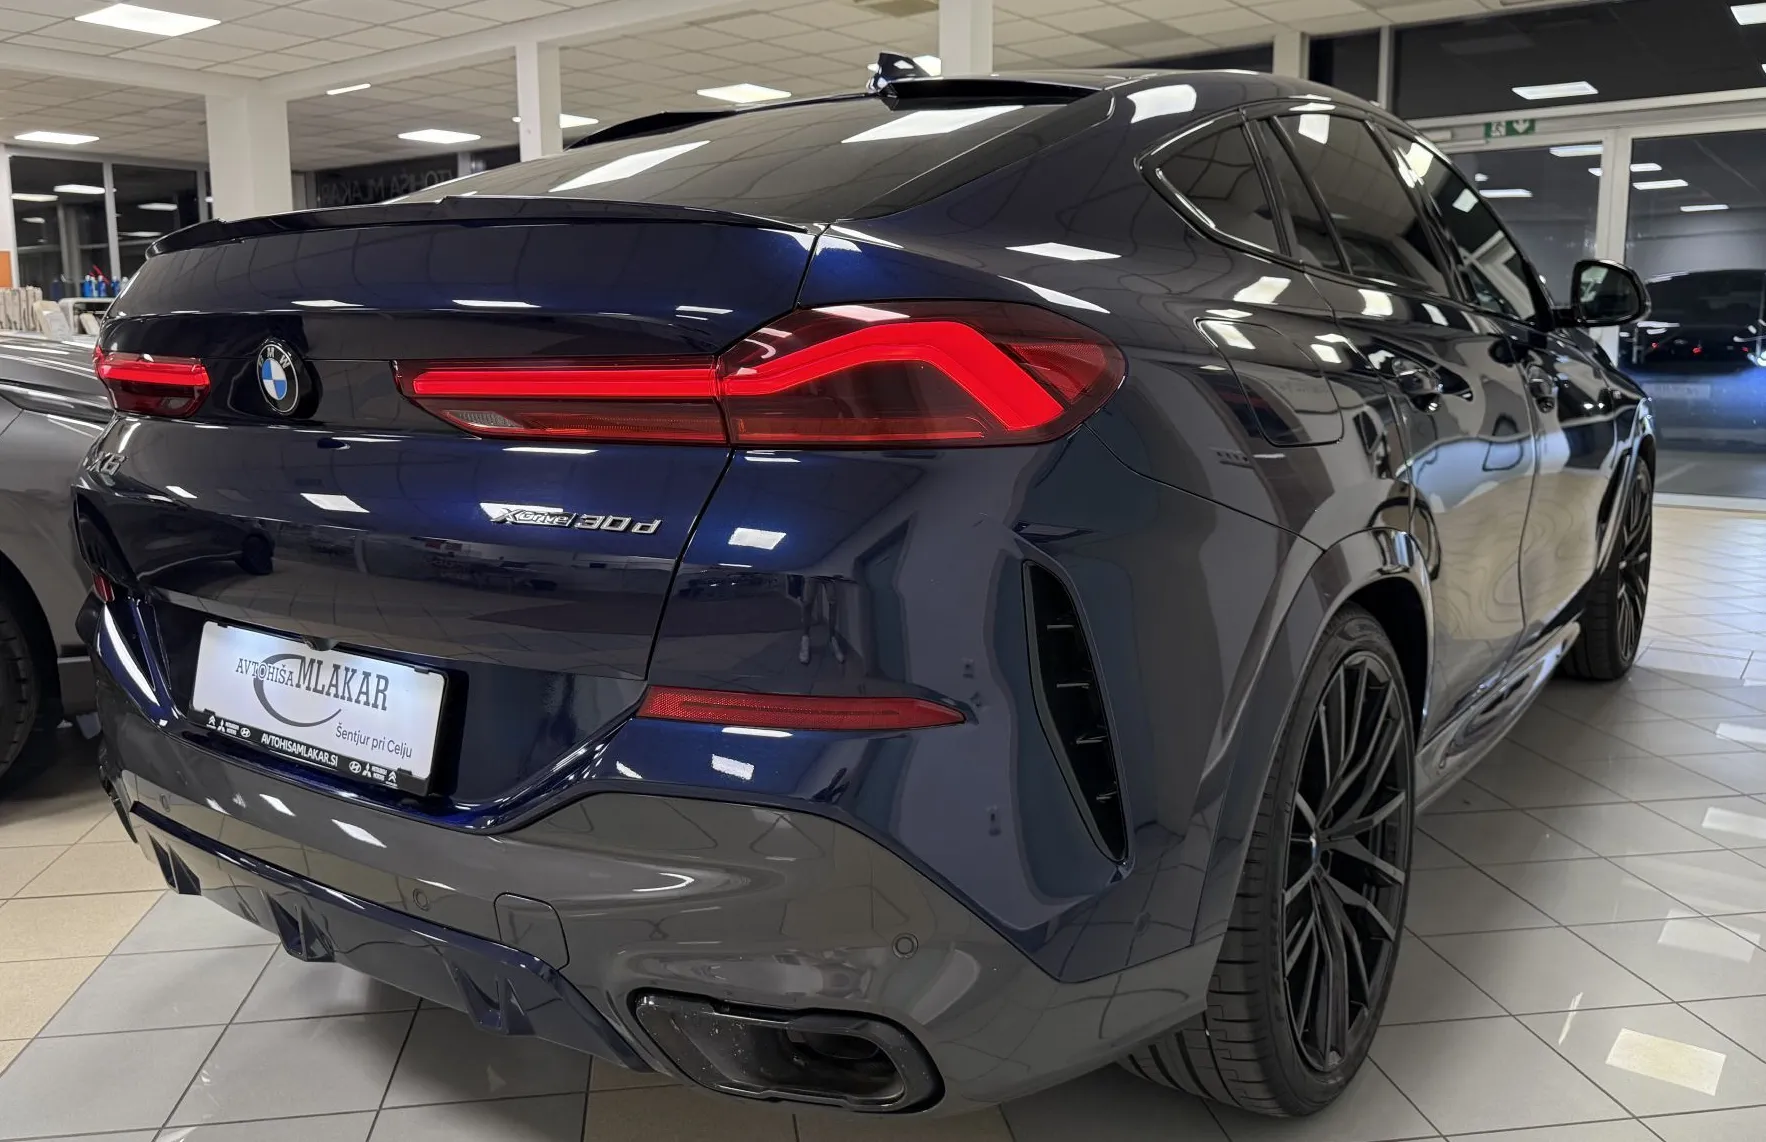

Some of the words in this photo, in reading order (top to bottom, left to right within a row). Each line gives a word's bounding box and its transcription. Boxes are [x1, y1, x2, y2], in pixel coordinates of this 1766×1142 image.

[258, 346, 291, 369] BMW
[87, 451, 126, 476] X6
[235, 657, 294, 688] AVTOHIŠA
[295, 656, 390, 711] MLAKAR
[261, 732, 338, 767] AVTOHISAMLAKAR.SI
[335, 722, 371, 746] Šentjur
[371, 736, 386, 751] pri
[387, 739, 413, 759] Celju
